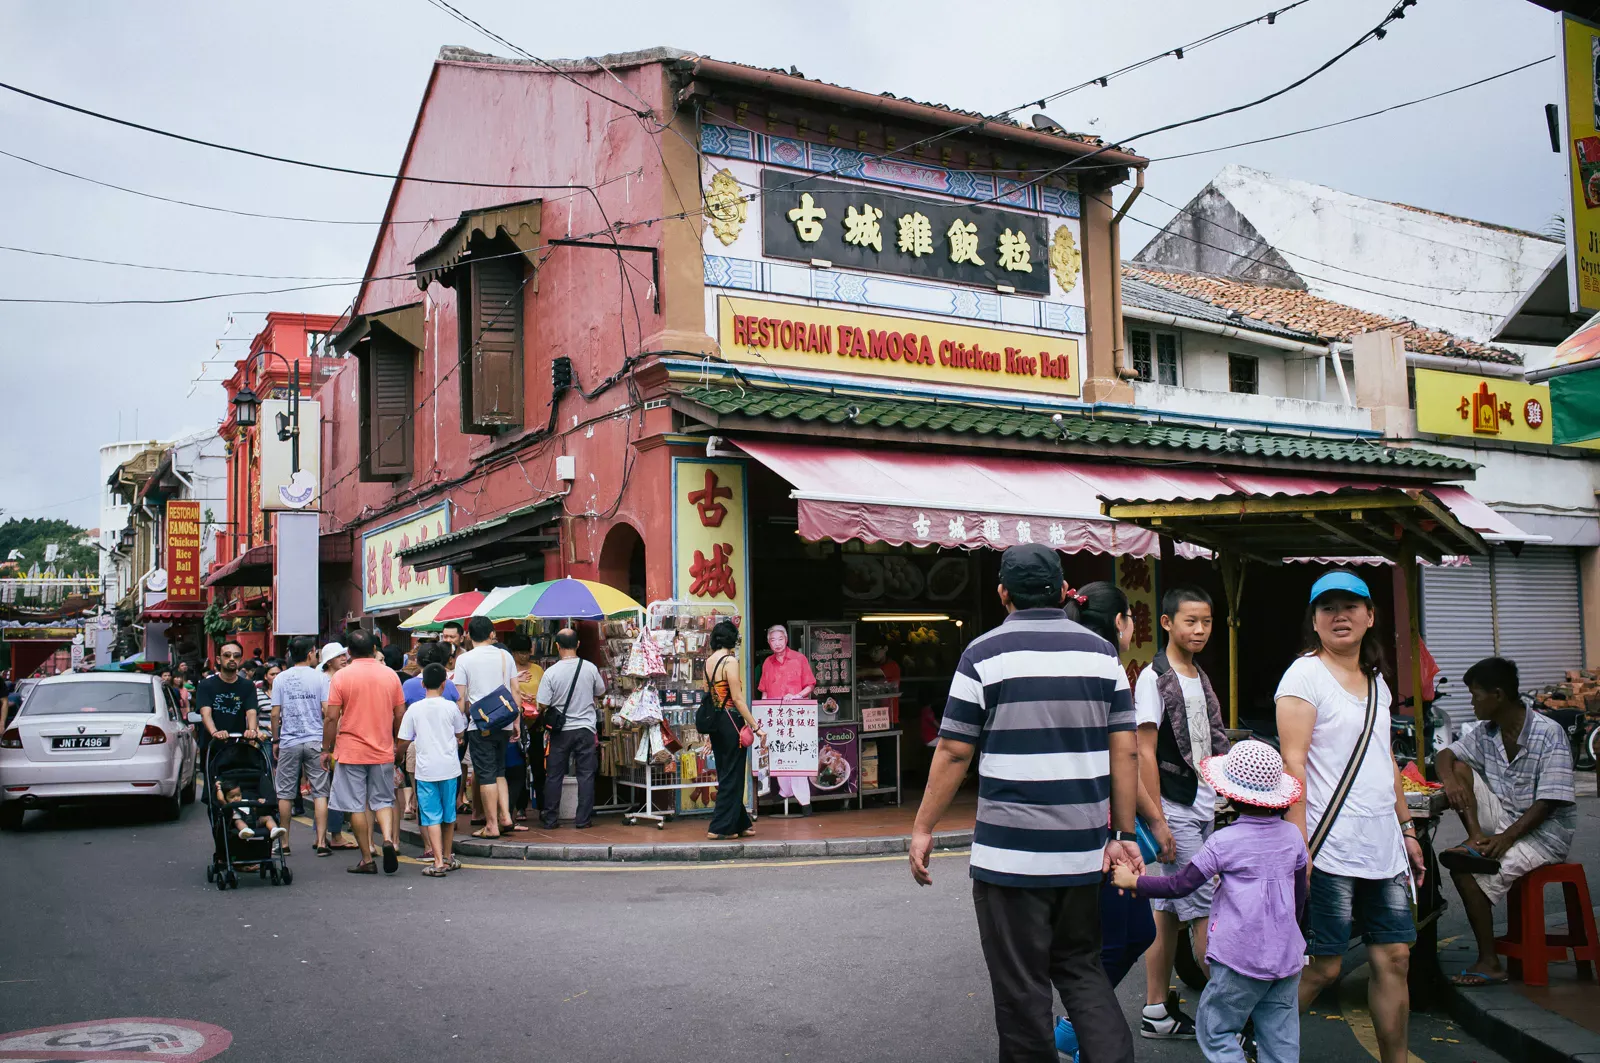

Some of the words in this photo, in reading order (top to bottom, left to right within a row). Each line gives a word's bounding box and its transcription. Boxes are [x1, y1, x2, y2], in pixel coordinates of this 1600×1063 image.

[786, 192, 1033, 273] 古城雞飯粒
[1589, 231, 1600, 254] Ji
[733, 314, 832, 354] RESTORAN
[837, 324, 936, 366] FAMOSA
[939, 339, 1002, 371] Chicken
[1004, 346, 1037, 376] Rice
[1040, 351, 1070, 380] Ball
[169, 506, 199, 519] RESTORAN
[169, 521, 198, 535] FAMOSA
[169, 536, 198, 547] Chicken
[176, 549, 192, 559] Rice
[176, 561, 191, 571] Ball
[59, 736, 78, 748] JNT
[79, 735, 102, 747] 7496
[826, 731, 852, 741] Cendol
